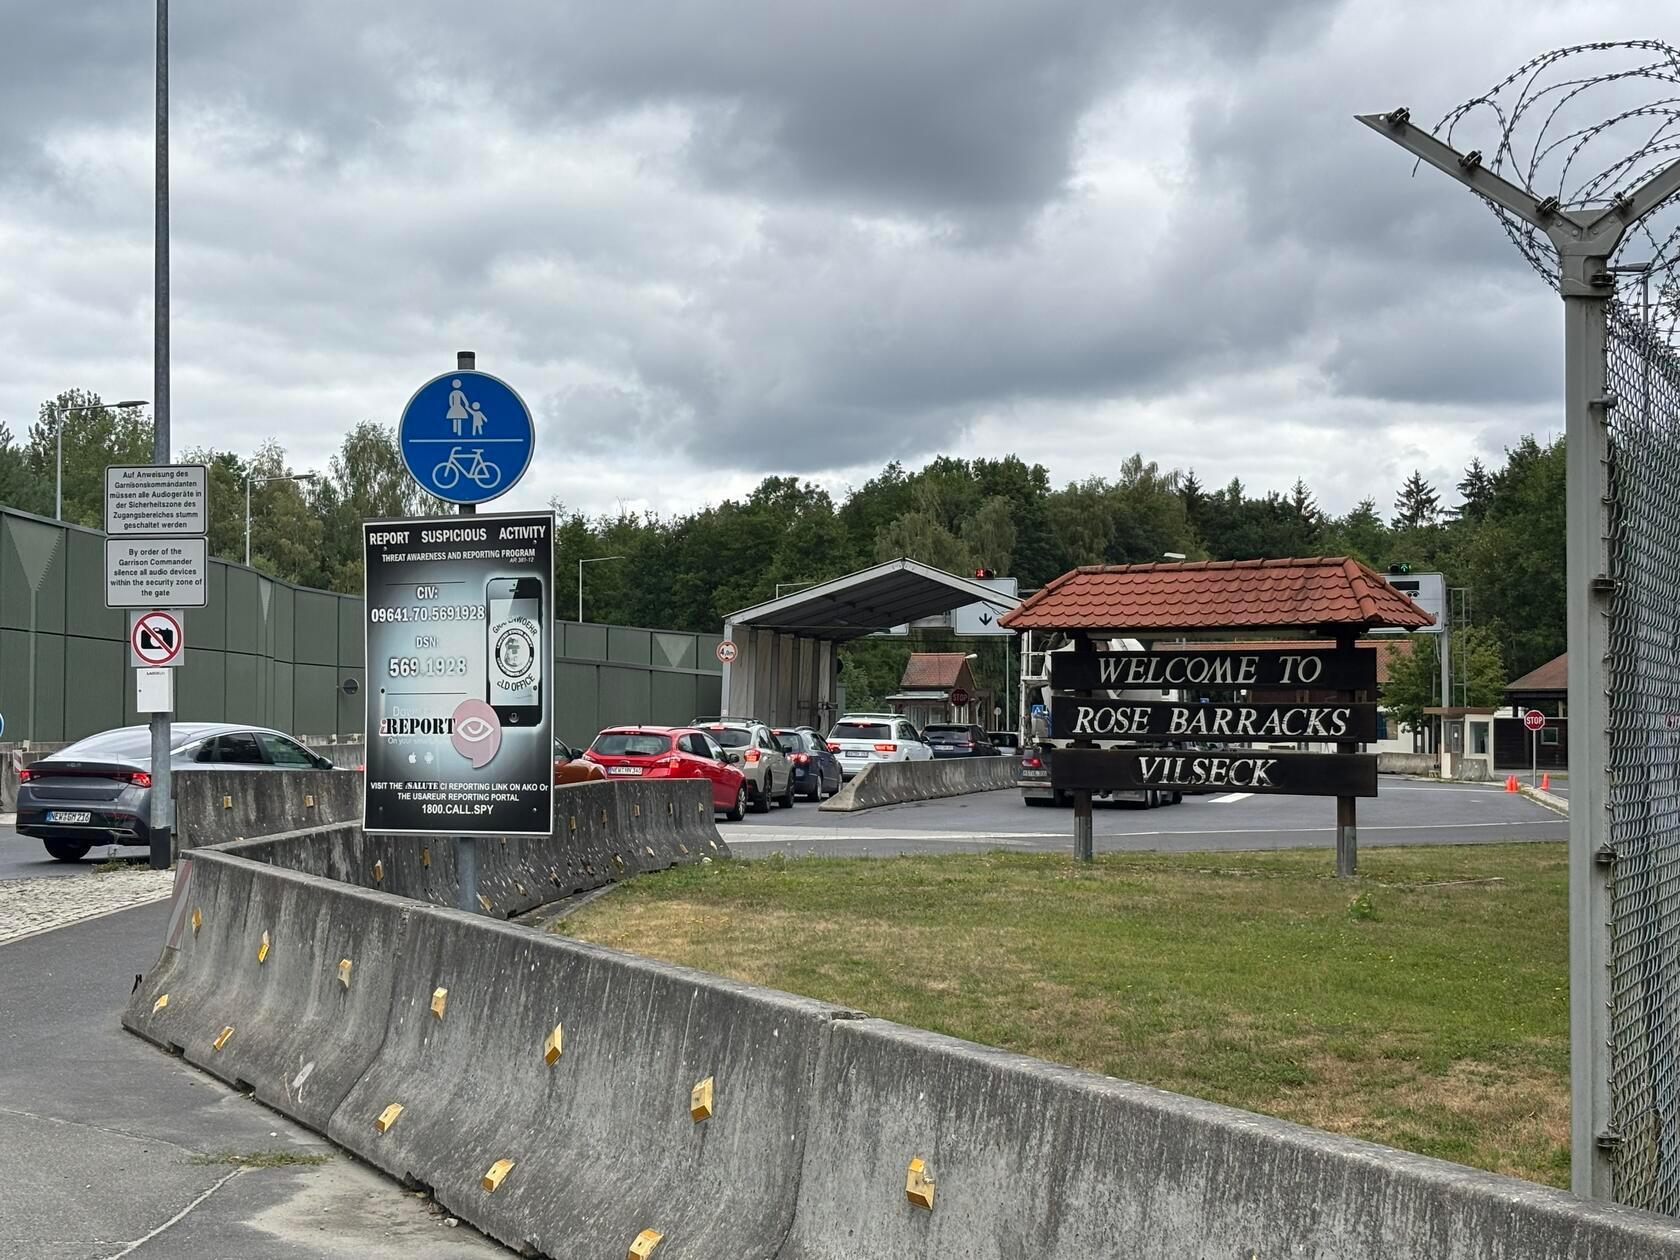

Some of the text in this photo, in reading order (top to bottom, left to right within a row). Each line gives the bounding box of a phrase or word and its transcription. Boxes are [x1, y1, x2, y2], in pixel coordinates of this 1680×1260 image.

[137, 471, 174, 479] Anweisung
[151, 491, 194, 499] Audiogeräte
[113, 512, 174, 520] Zugangsbereiches
[124, 522, 160, 530] geschaltet
[369, 525, 546, 545] REPORT SUSPICIOUS ACTIVITY
[128, 548, 138, 557] By
[382, 548, 535, 562] THREAT AWARENESS AND REPORTING PROGRAM
[146, 579, 174, 587] security
[416, 586, 438, 599] CIV:
[371, 606, 486, 622] 09641.70.5691928
[416, 637, 438, 648] DSN:
[389, 658, 466, 677] 569.1928
[1099, 656, 1322, 684] WELCOME TO
[511, 673, 535, 692] OFFICE
[1072, 706, 1350, 736] ROSE BARRACKS
[1526, 716, 1543, 724] STOP
[1138, 756, 1278, 787] VILSECK
[370, 782, 388, 790] VISIT
[422, 804, 494, 814] 1800.CALL.SPY
[52, 812, 63, 821] NEW
